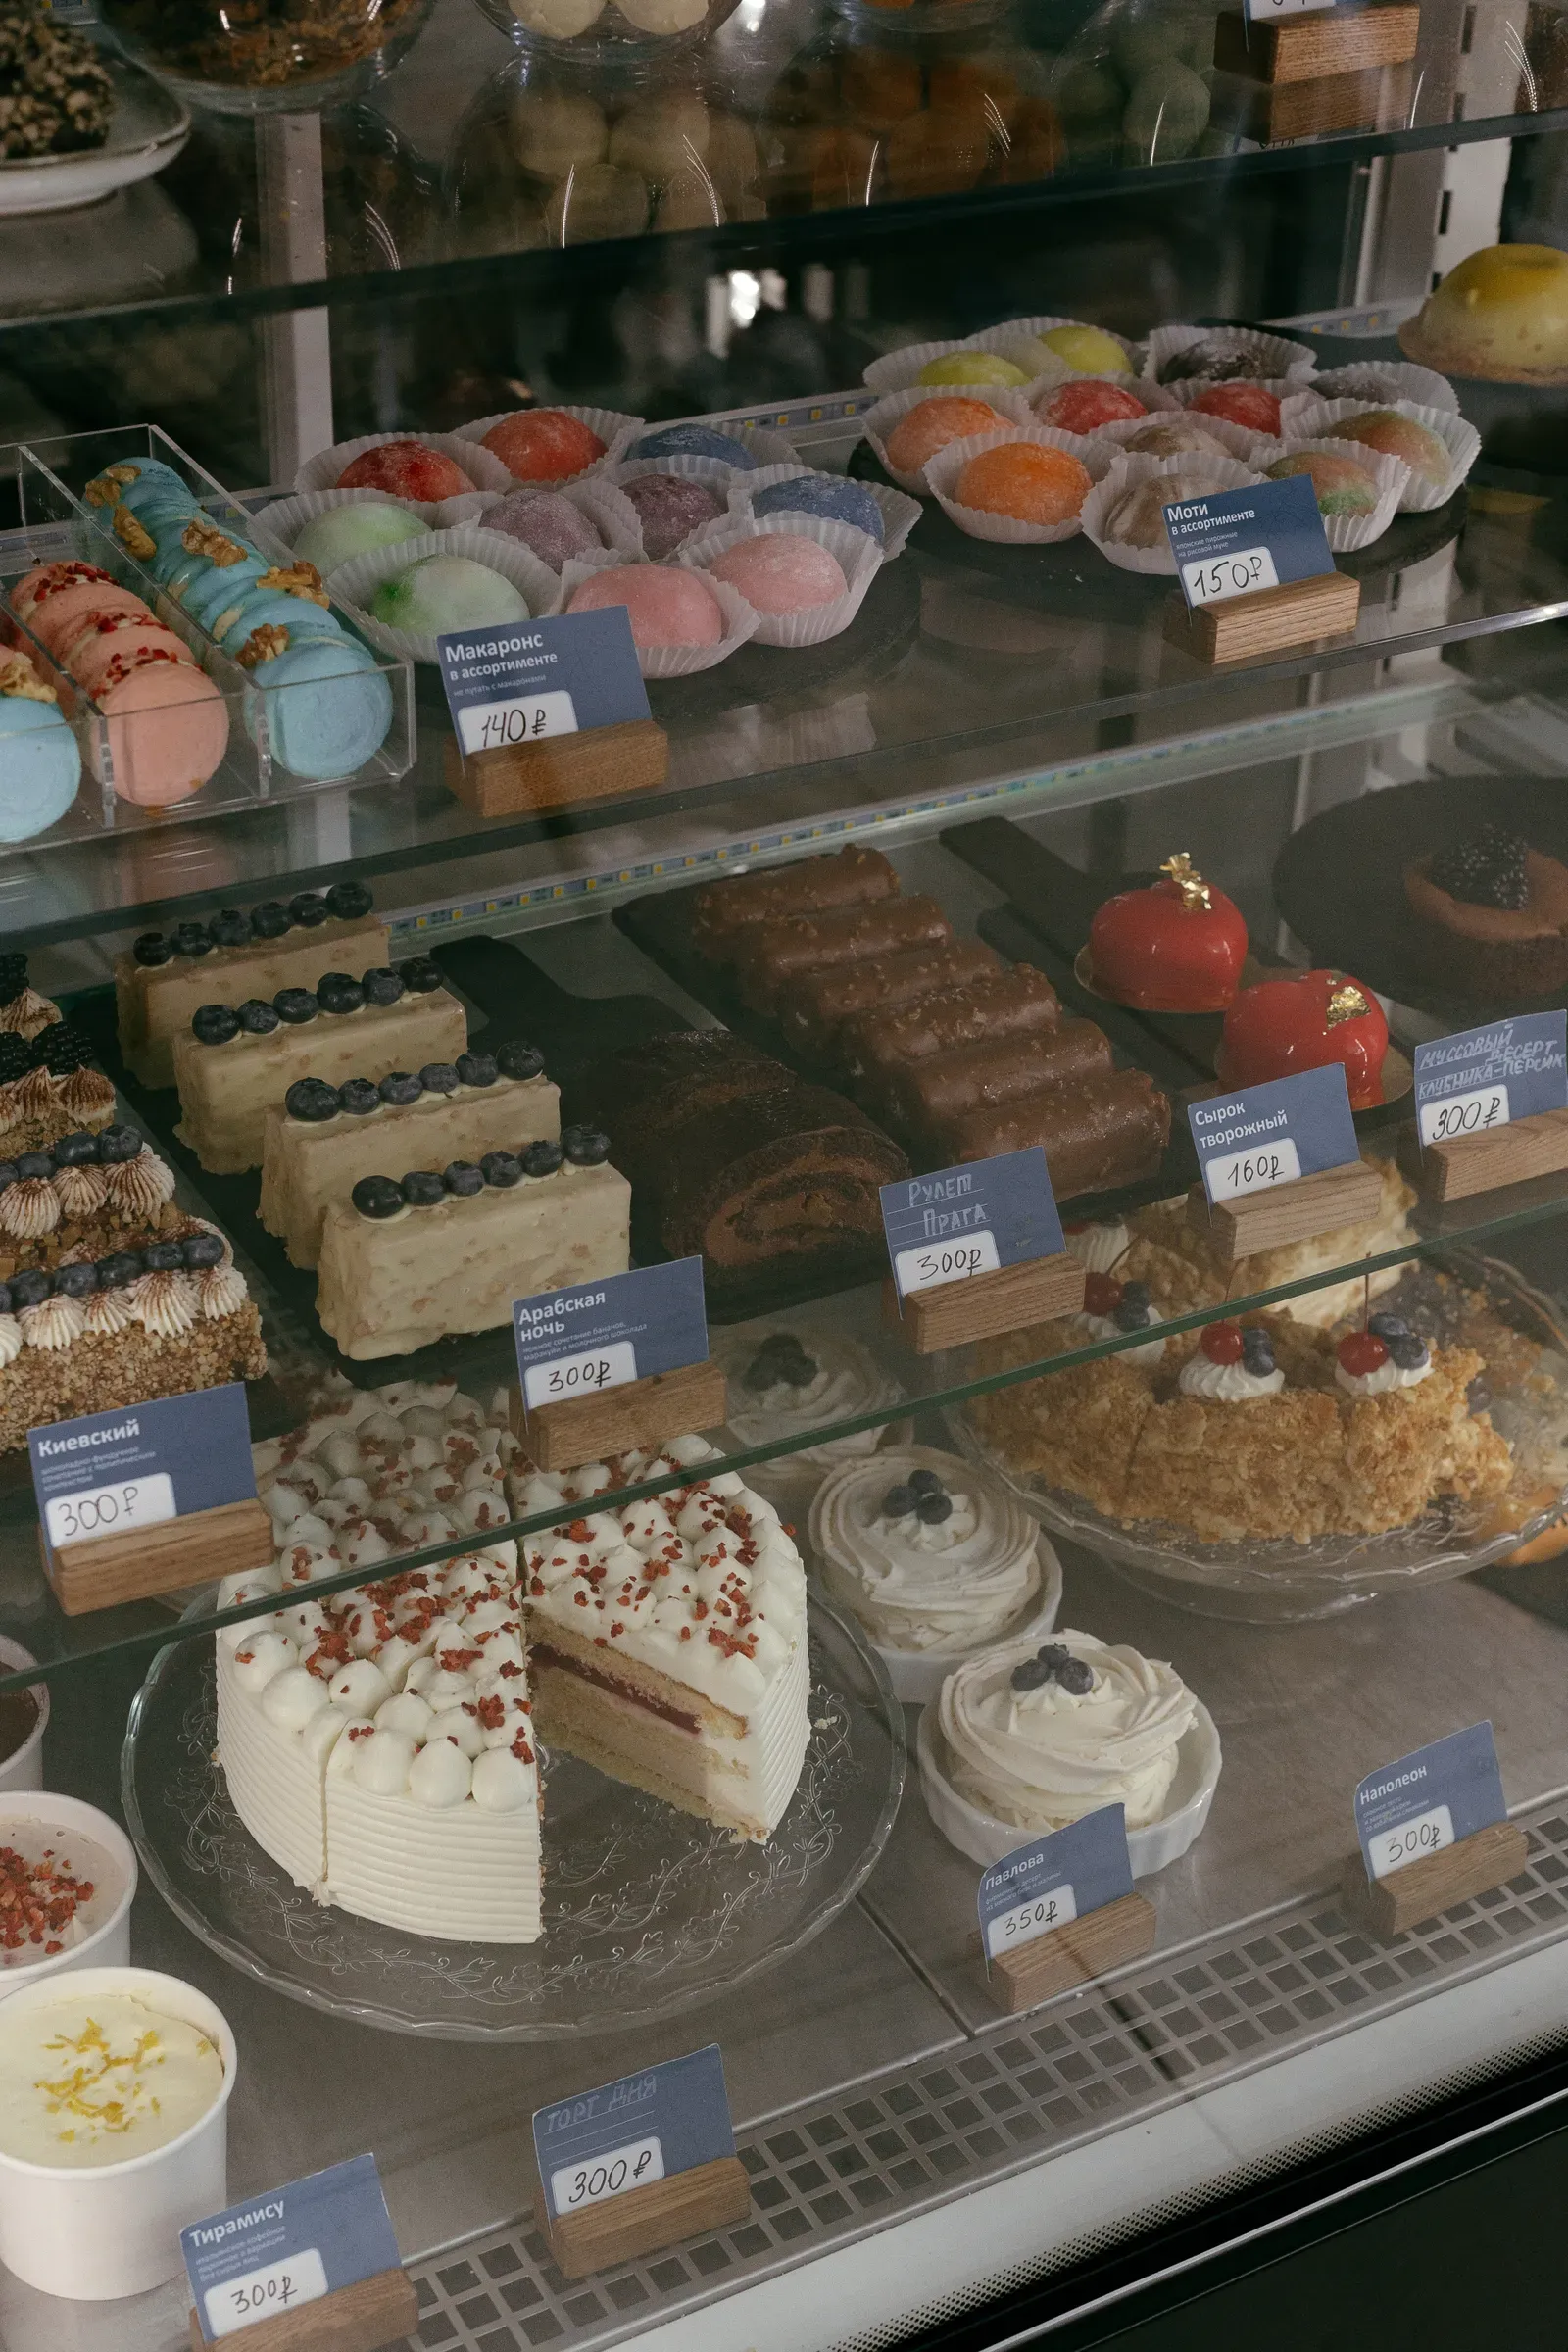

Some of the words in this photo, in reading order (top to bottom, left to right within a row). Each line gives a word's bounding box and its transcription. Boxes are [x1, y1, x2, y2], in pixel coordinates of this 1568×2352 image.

[1167, 504, 1208, 522] Моти
[1171, 526, 1179, 536] в
[1181, 509, 1255, 533] ассортименте
[446, 634, 543, 662] Макаронс
[450, 669, 459, 681] в
[462, 652, 558, 679] ассортименте
[1195, 1102, 1246, 1126] Сырок
[1200, 1109, 1288, 1149] творожный
[518, 1292, 606, 1325] Арабская
[520, 1321, 565, 1342] ночь
[38, 1419, 140, 1457] Киевский
[1360, 1765, 1427, 1805] Наполеон
[985, 1853, 1044, 1890] Павлова
[189, 2200, 284, 2247] Тирамису
